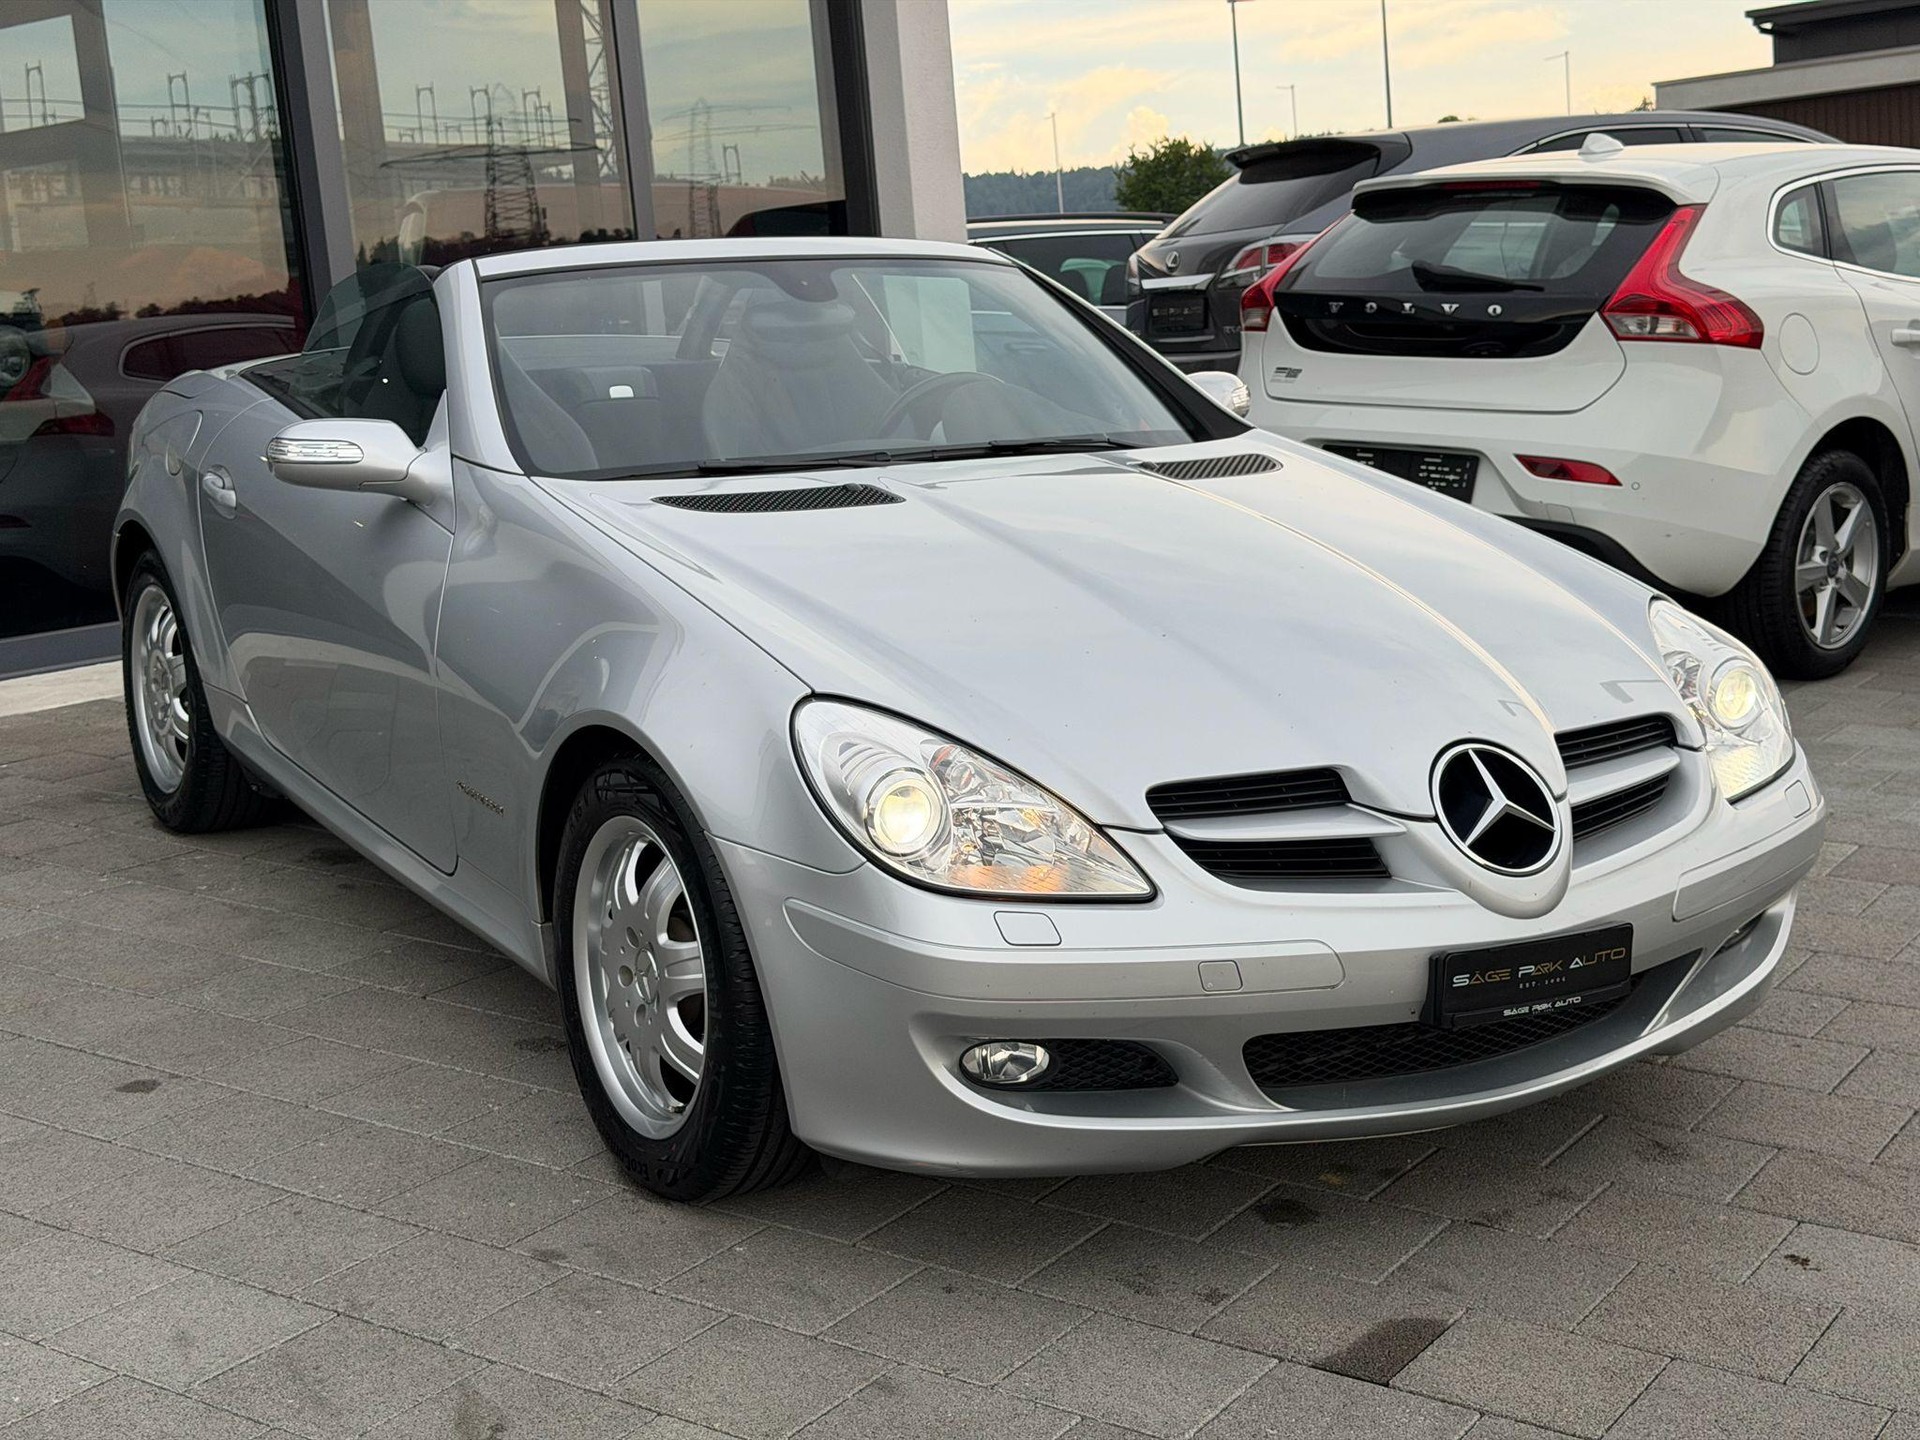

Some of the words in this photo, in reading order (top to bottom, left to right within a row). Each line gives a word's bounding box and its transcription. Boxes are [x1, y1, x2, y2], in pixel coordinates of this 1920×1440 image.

[1328, 301, 1502, 316] VOLVO
[1452, 969, 1511, 987] SAGE
[1518, 960, 1563, 978] PARK
[1569, 947, 1626, 969] AUTO
[1503, 1006, 1529, 1016] SAGE
[1554, 997, 1581, 1007] AUTO
